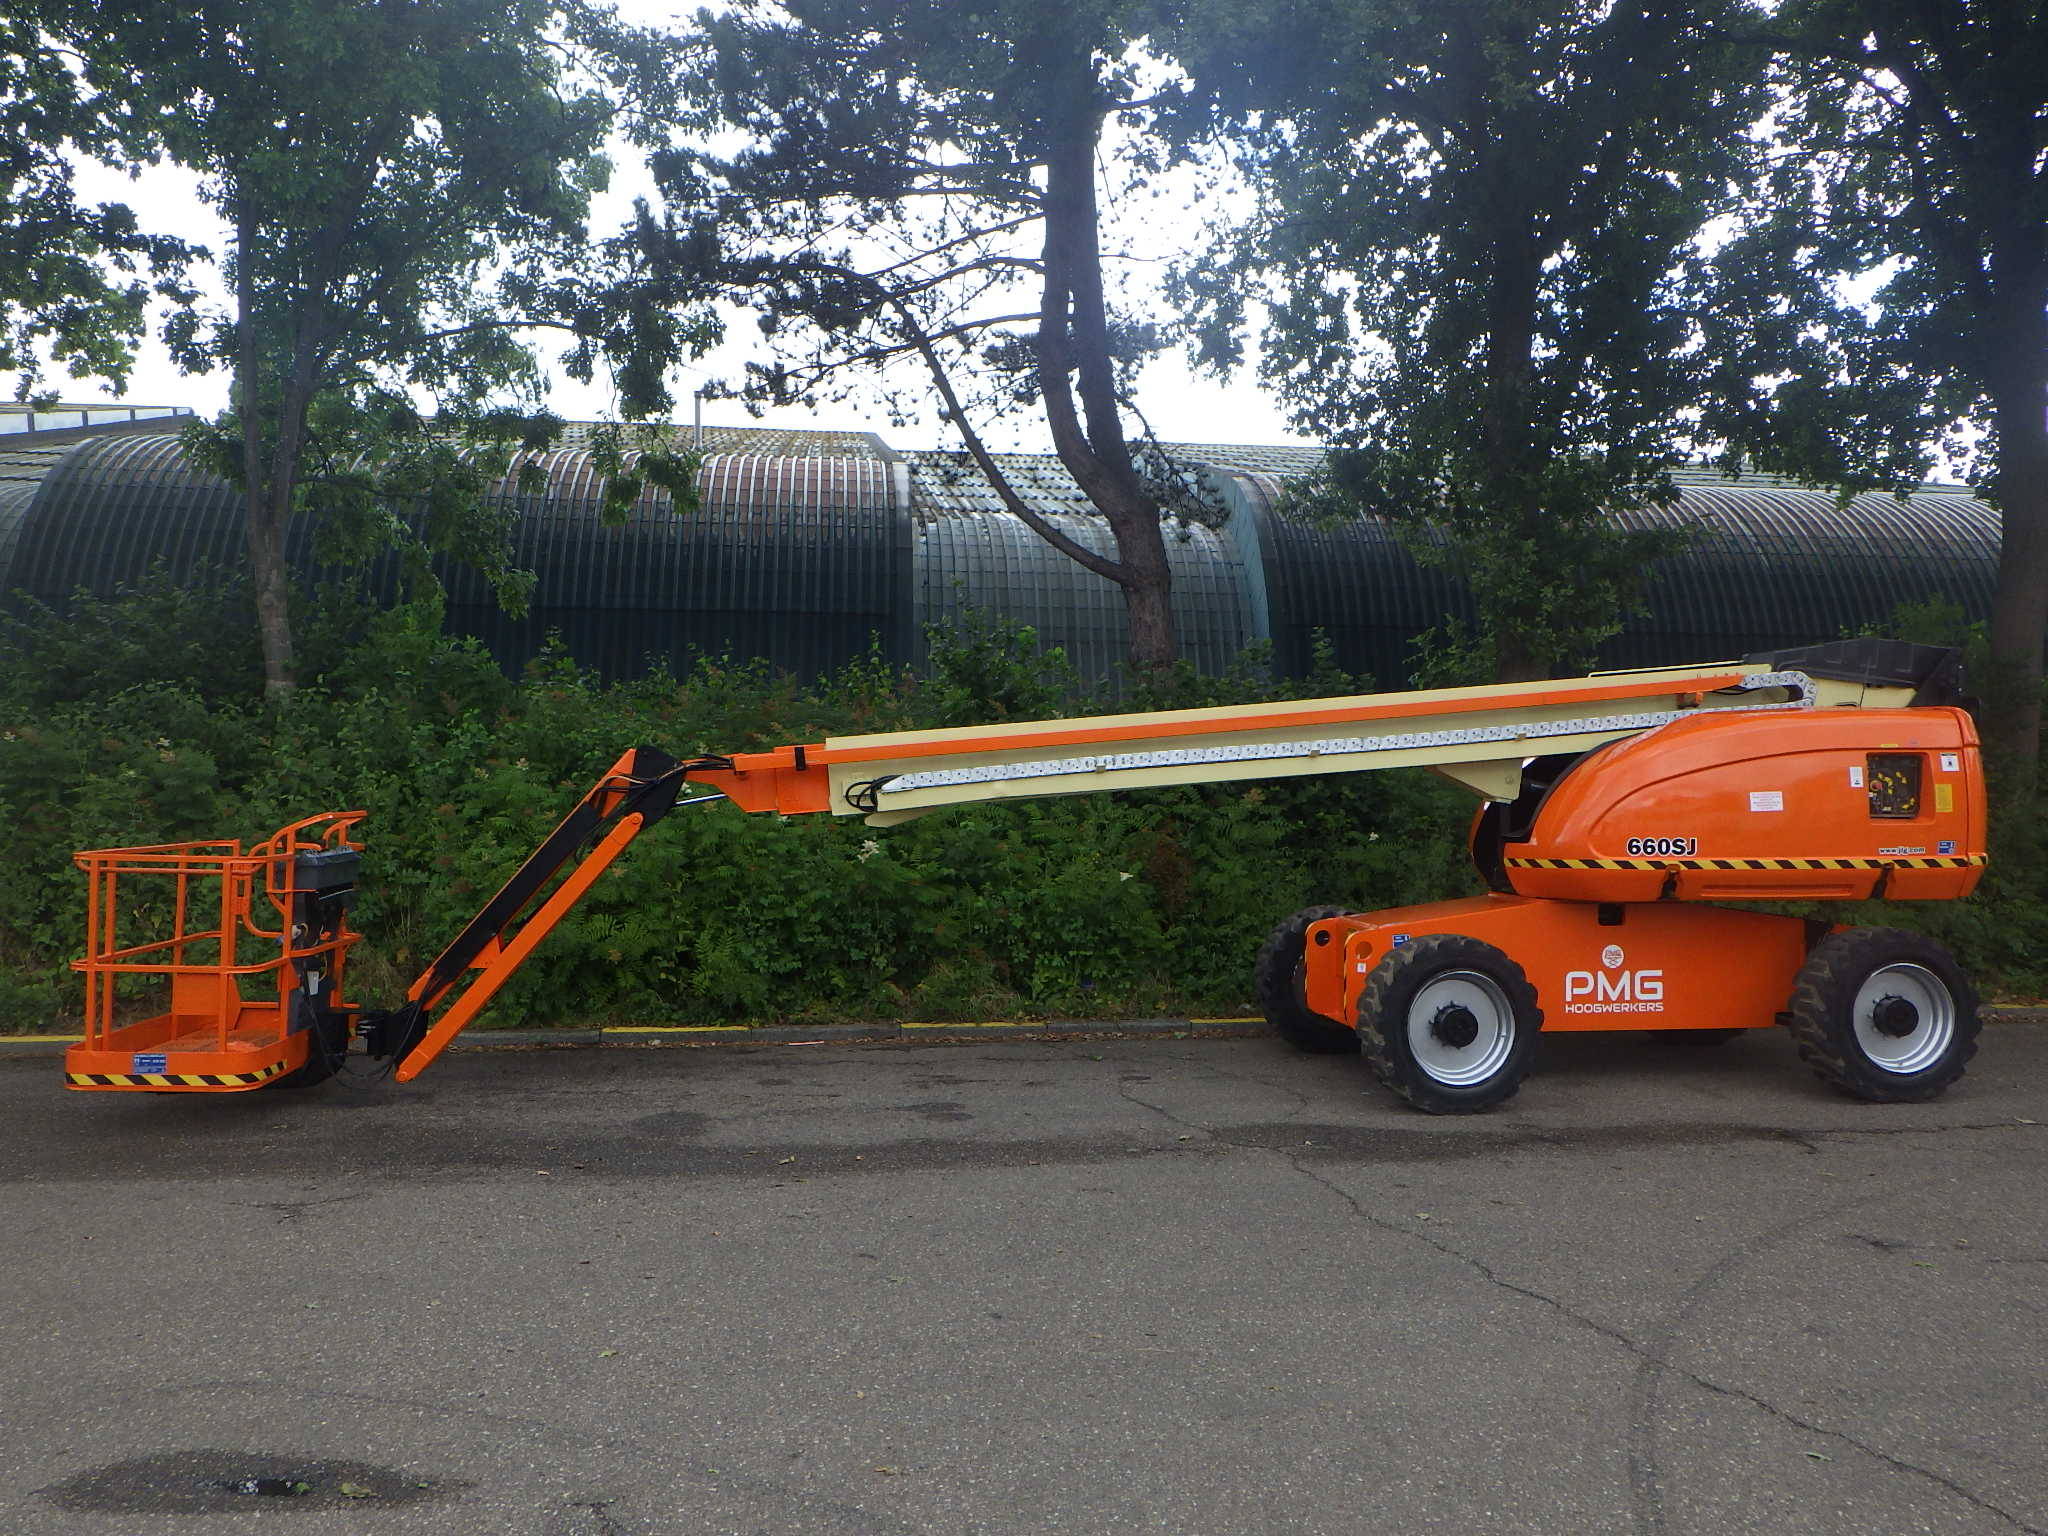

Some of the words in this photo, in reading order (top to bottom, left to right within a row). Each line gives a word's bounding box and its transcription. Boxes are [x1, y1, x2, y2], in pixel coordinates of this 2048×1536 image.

[1627, 837, 1697, 856] 660SJ
[1565, 970, 1664, 1001] PMG
[1565, 1003, 1664, 1014] HOOGWERKERS
